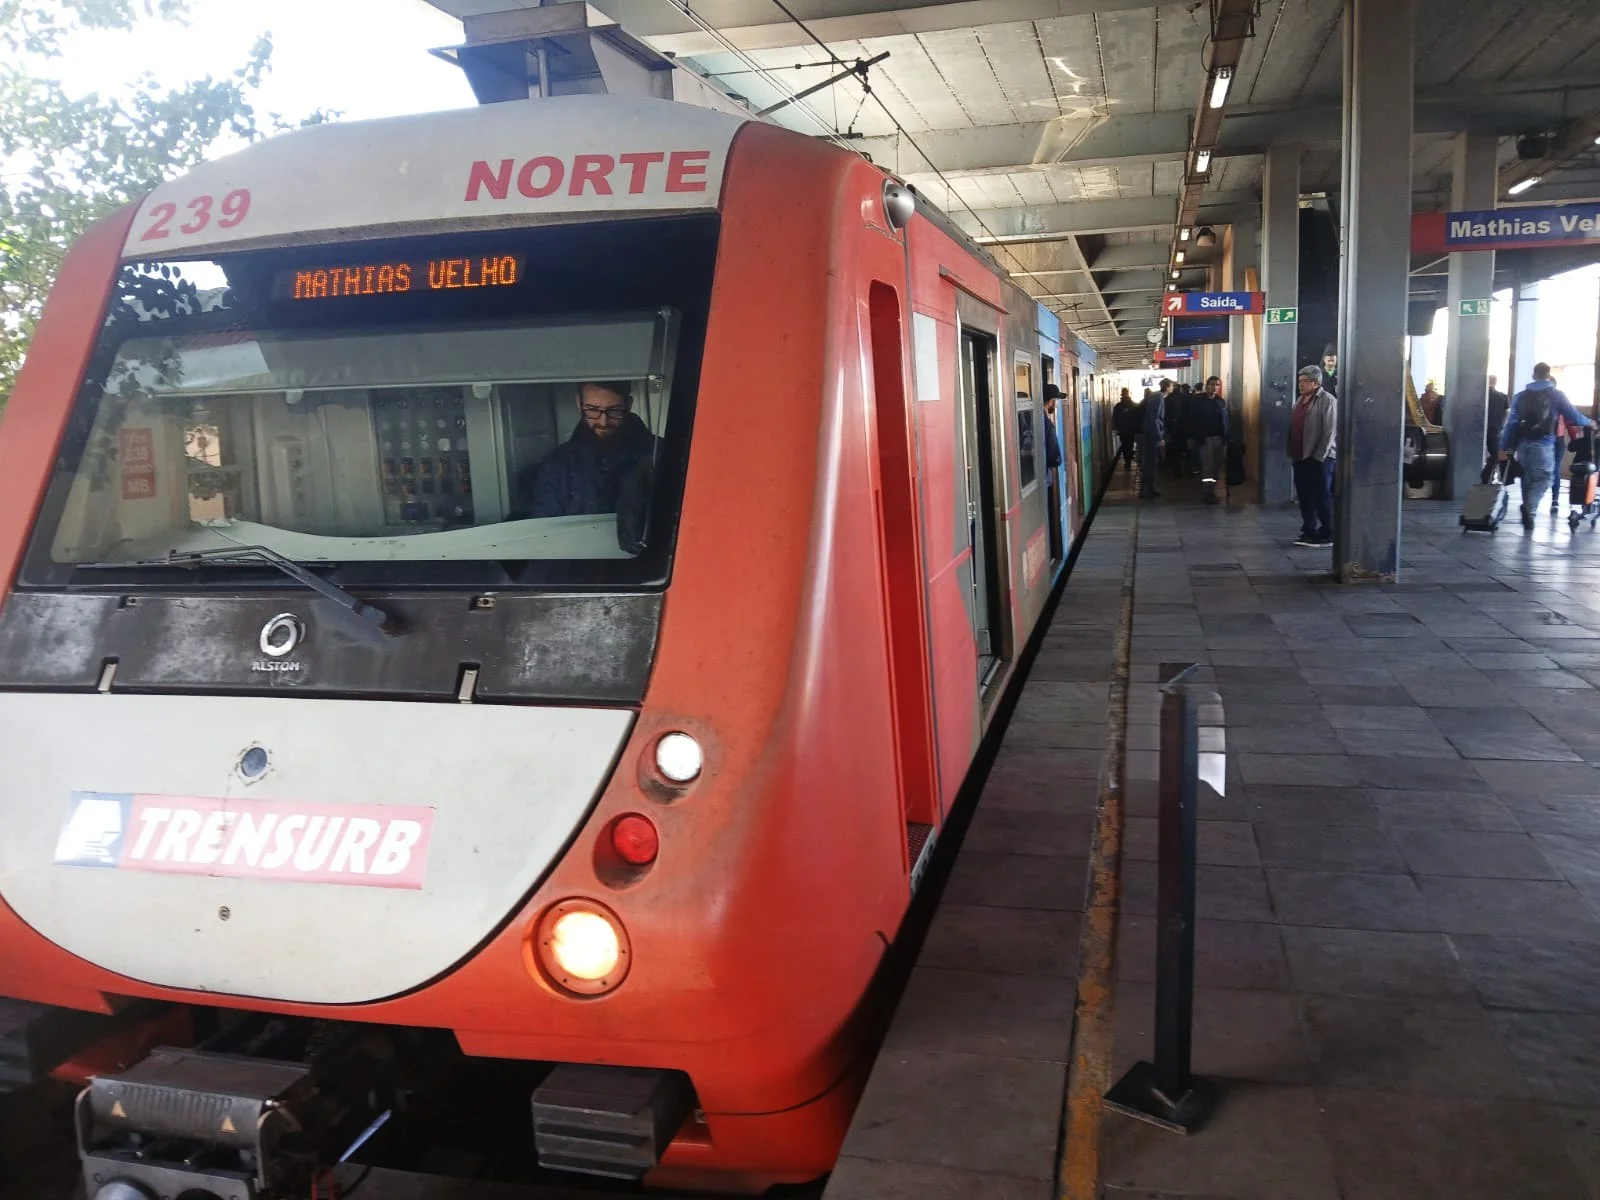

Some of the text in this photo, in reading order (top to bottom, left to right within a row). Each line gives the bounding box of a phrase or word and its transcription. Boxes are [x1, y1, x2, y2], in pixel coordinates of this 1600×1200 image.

[465, 150, 710, 202] NORTE
[140, 189, 250, 242] 239
[1450, 218, 1551, 239] Mathias
[294, 255, 518, 300] MATHIAS VELHO
[1200, 297, 1237, 308] Saída
[251, 661, 301, 672] ALSTOM
[128, 806, 422, 876] TRENSURB
